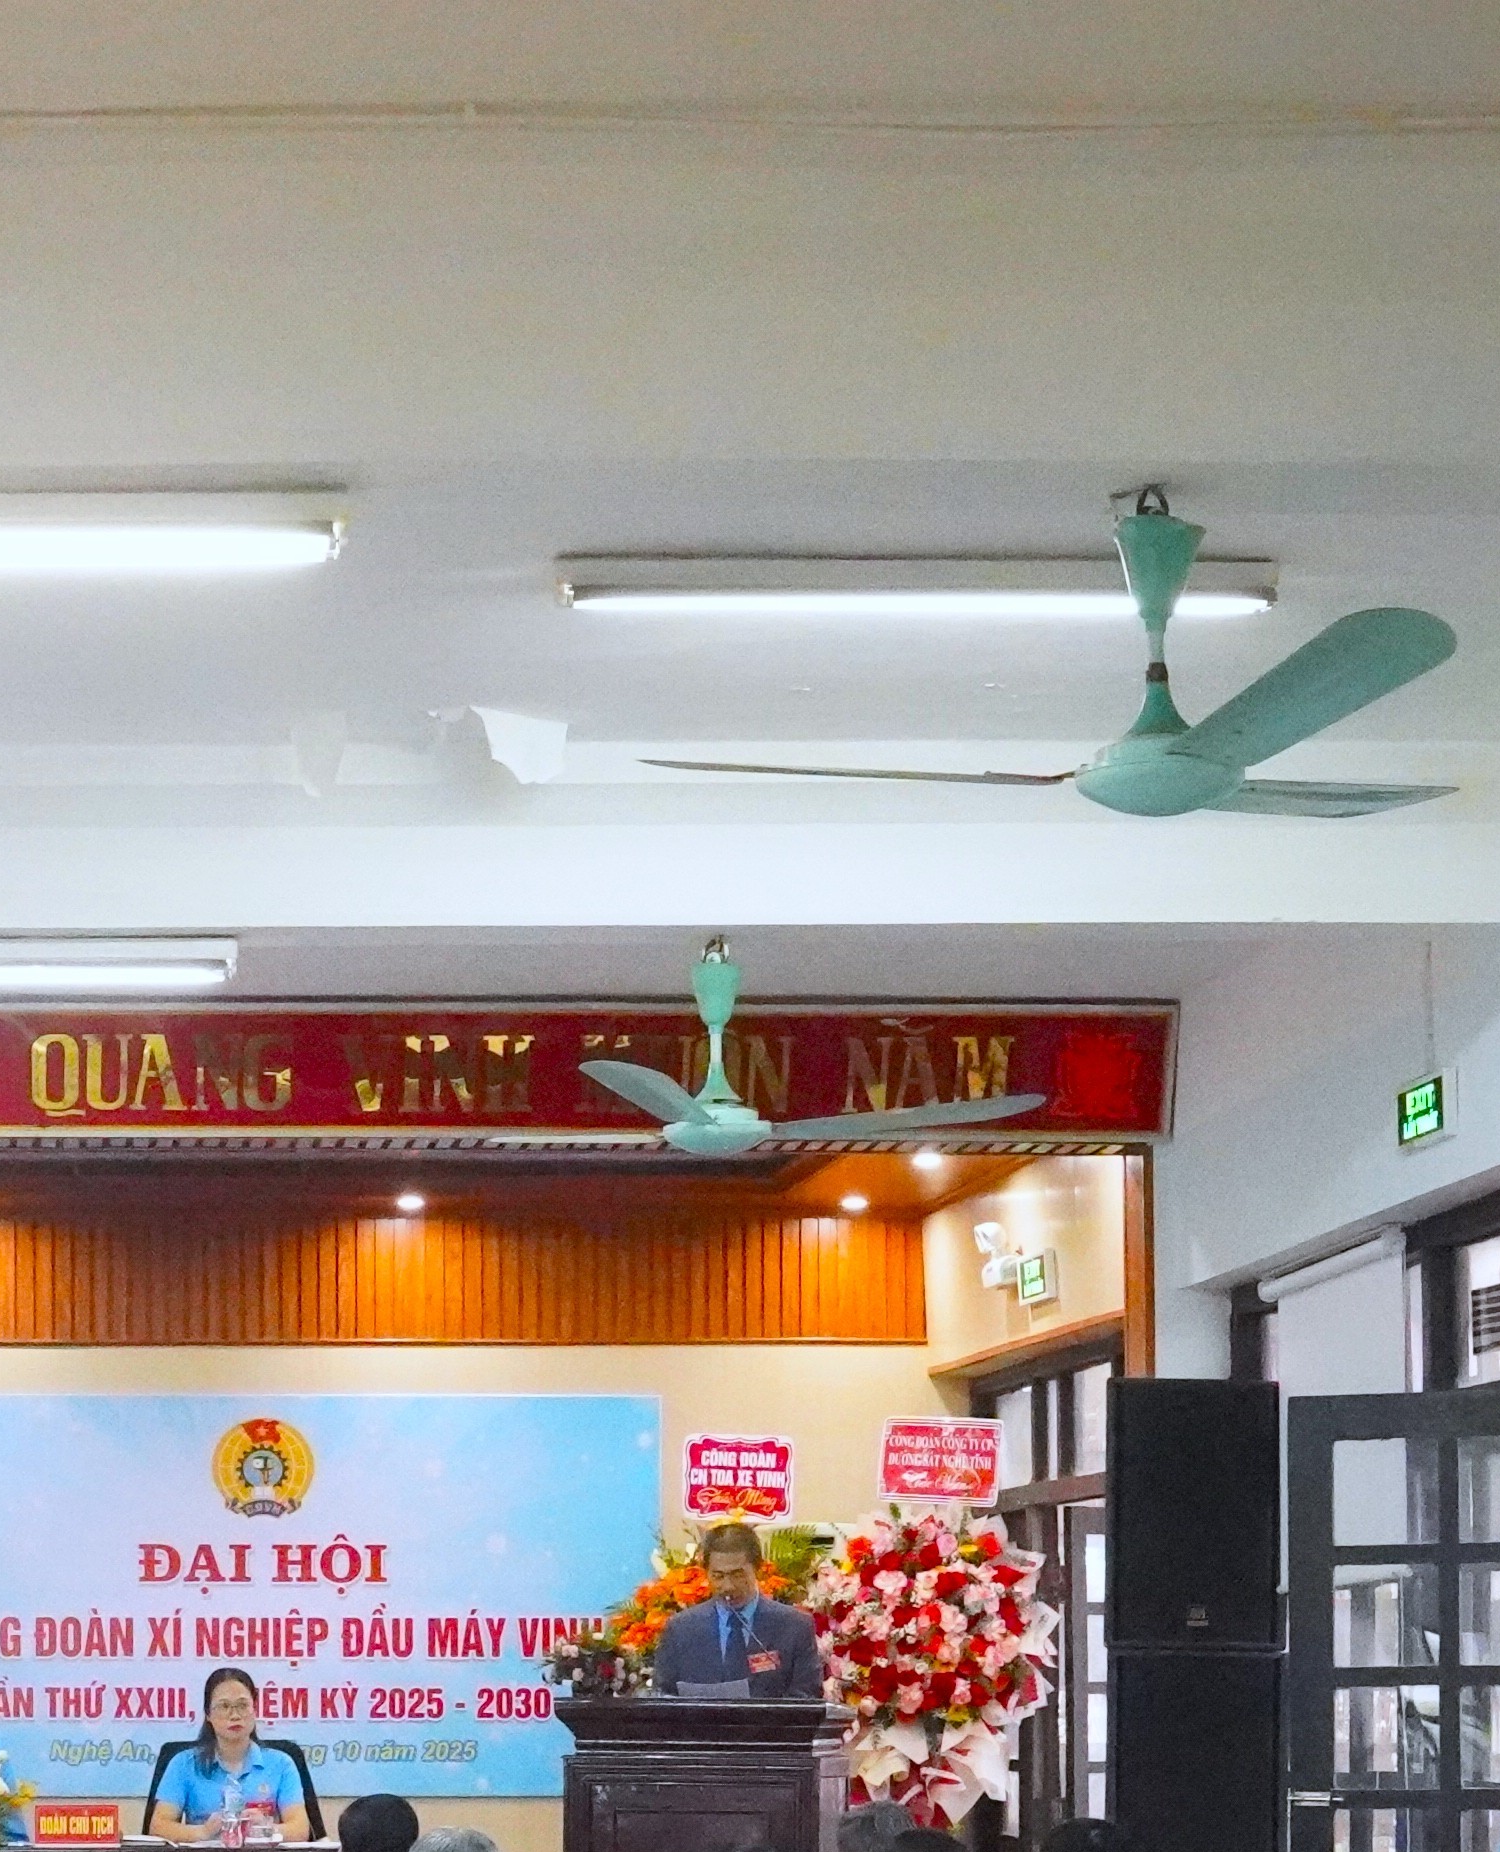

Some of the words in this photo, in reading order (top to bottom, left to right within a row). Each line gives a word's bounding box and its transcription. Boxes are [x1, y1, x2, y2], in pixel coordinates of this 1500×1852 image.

[31, 1032, 293, 1118] QUANG
[339, 1033, 536, 1113] VINH
[701, 1447, 737, 1467] CÔNG
[690, 1468, 707, 1486] CN
[710, 1468, 735, 1486] TOA
[736, 1469, 754, 1487] XE
[756, 1470, 785, 1489] VINH
[138, 1543, 252, 1595] ĐẠI
[272, 1533, 388, 1595] HỘI
[34, 1608, 134, 1657] ĐOÀN
[146, 1608, 182, 1657] XÍ
[195, 1608, 329, 1667] NGHIỆP
[340, 1603, 413, 1657] ĐẦU
[427, 1609, 506, 1657] MÁY
[45, 1681, 106, 1718] THỨ
[114, 1687, 195, 1723] XXIII,
[321, 1681, 359, 1718] KỲ
[369, 1688, 443, 1719] 2025
[477, 1688, 551, 1719] 2030
[50, 1739, 113, 1766] Nghệ
[115, 1740, 156, 1765] An,
[333, 1741, 361, 1762] 10
[363, 1740, 417, 1763] năm
[421, 1740, 478, 1763] 2025
[40, 1812, 67, 1834] ĐOÀN
[69, 1809, 90, 1834] CHỦ
[91, 1816, 114, 1839] TỊCH
